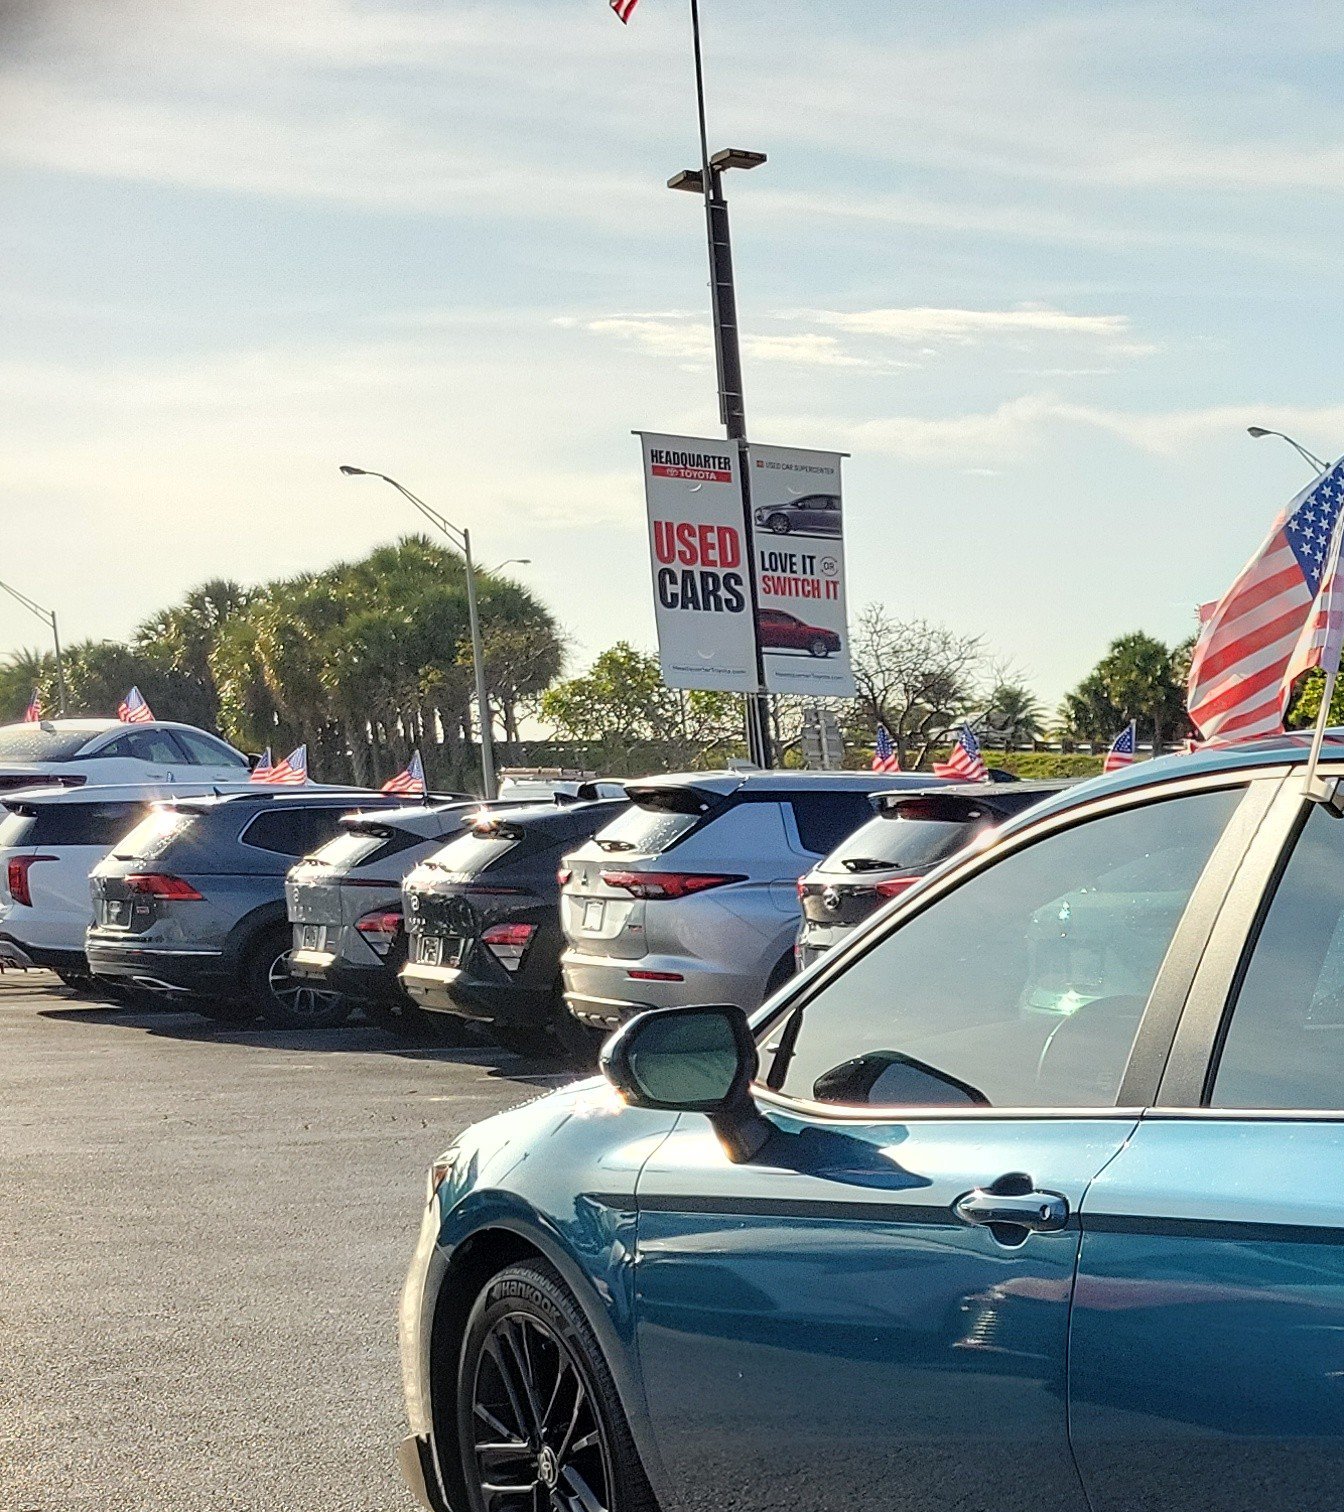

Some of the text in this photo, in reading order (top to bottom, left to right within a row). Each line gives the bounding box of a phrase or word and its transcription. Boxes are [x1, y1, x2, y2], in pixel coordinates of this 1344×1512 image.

[650, 448, 731, 471] HEADQUARTER
[680, 469, 717, 480] TOYOTA
[654, 520, 742, 569] USED
[760, 550, 798, 574] LOVE
[801, 554, 816, 576] IT
[657, 566, 746, 614] CARS
[762, 574, 840, 600] SWITCH IT
